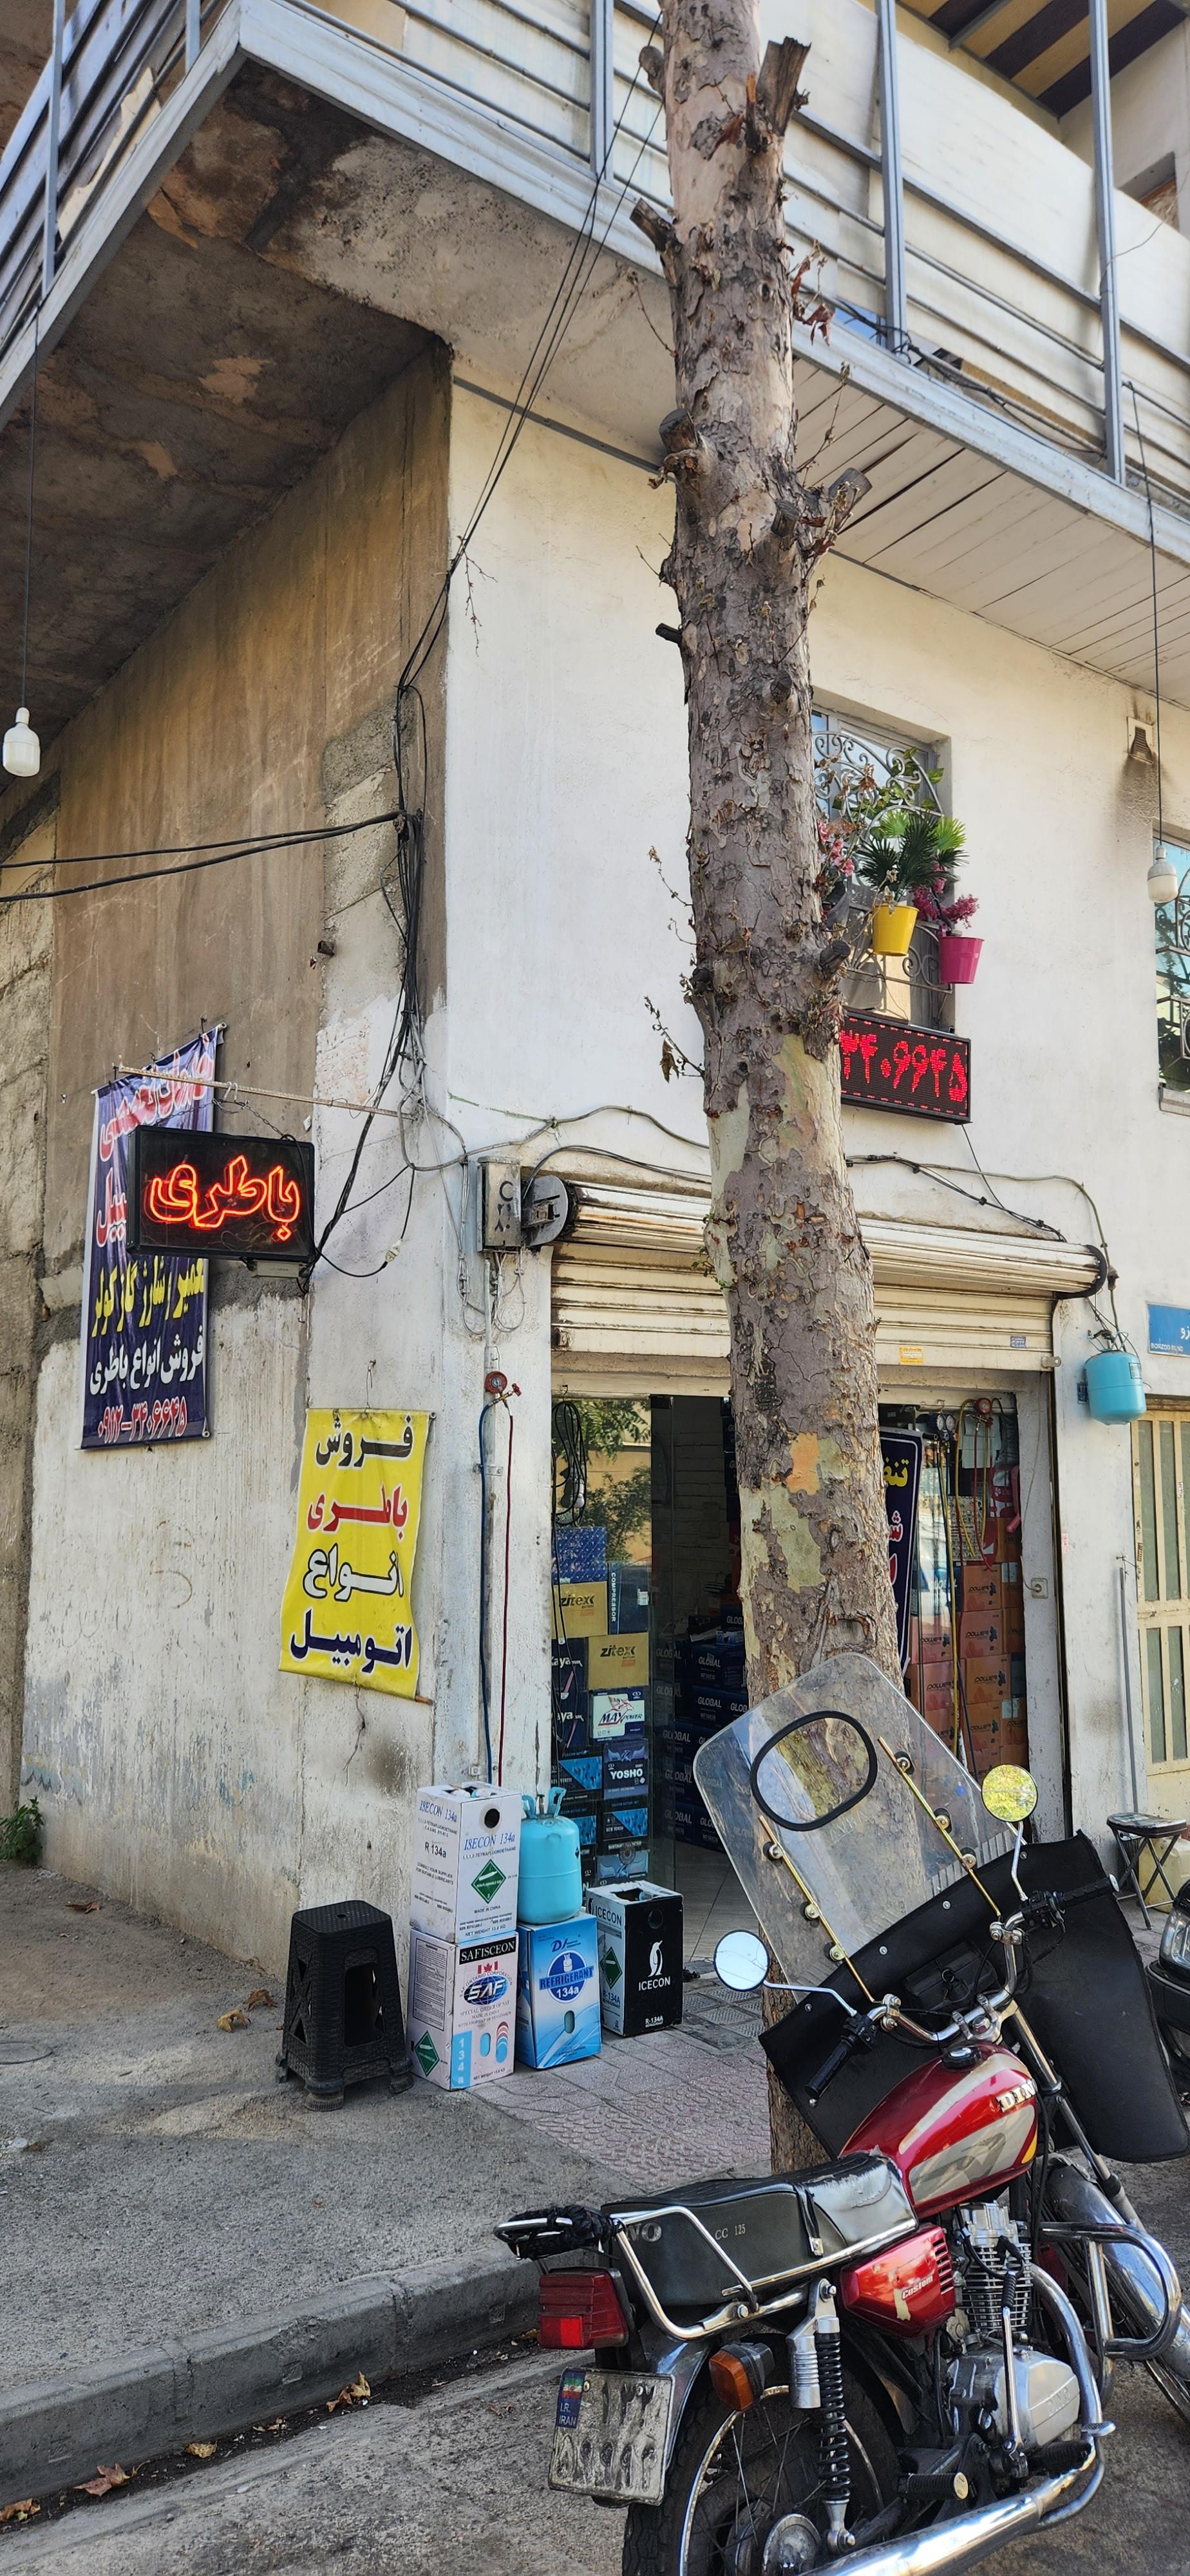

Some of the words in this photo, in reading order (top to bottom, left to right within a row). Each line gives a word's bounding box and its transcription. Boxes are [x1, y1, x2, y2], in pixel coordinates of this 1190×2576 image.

[149, 1155, 300, 1241] باطری
[116, 1260, 138, 1332] گاز
[173, 1258, 204, 1318] عمیر
[91, 1265, 117, 1338] کولر
[131, 1336, 161, 1390] انواع
[160, 1325, 203, 1384] فروش
[90, 1344, 128, 1396] باطری
[315, 1414, 413, 1468] فروش
[307, 1484, 408, 1540] باطری
[302, 1542, 404, 1602] انواع
[726, 1615, 743, 1625] GLOB
[290, 1608, 413, 1673] اتومبیل
[600, 1645, 636, 1657] zitex
[698, 1656, 721, 1668] GLOBAL
[927, 1682, 951, 1690] POWER
[974, 1675, 997, 1683] POWER
[697, 1696, 722, 1708] GLOBAL
[730, 1702, 748, 1713] GLOB
[610, 1768, 643, 1780] YOSHO
[444, 1808, 457, 1823] 134a
[500, 1832, 515, 1845] 134a
[425, 1841, 429, 1853] R
[431, 1844, 446, 1858] 134a
[595, 1906, 622, 1926] ICECON
[461, 1941, 515, 1961] SAFISCEON
[540, 1967, 594, 1989] REFRIGERANT
[638, 1976, 670, 1991] ICECON
[468, 1979, 506, 2000] SAF
[556, 1986, 579, 1998] 134a
[645, 2015, 663, 2024] R-134A
[996, 2078, 1037, 2112] DIN
[715, 2228, 728, 2240] CC
[734, 2224, 746, 2236] 125
[559, 2416, 576, 2426] IRAN
